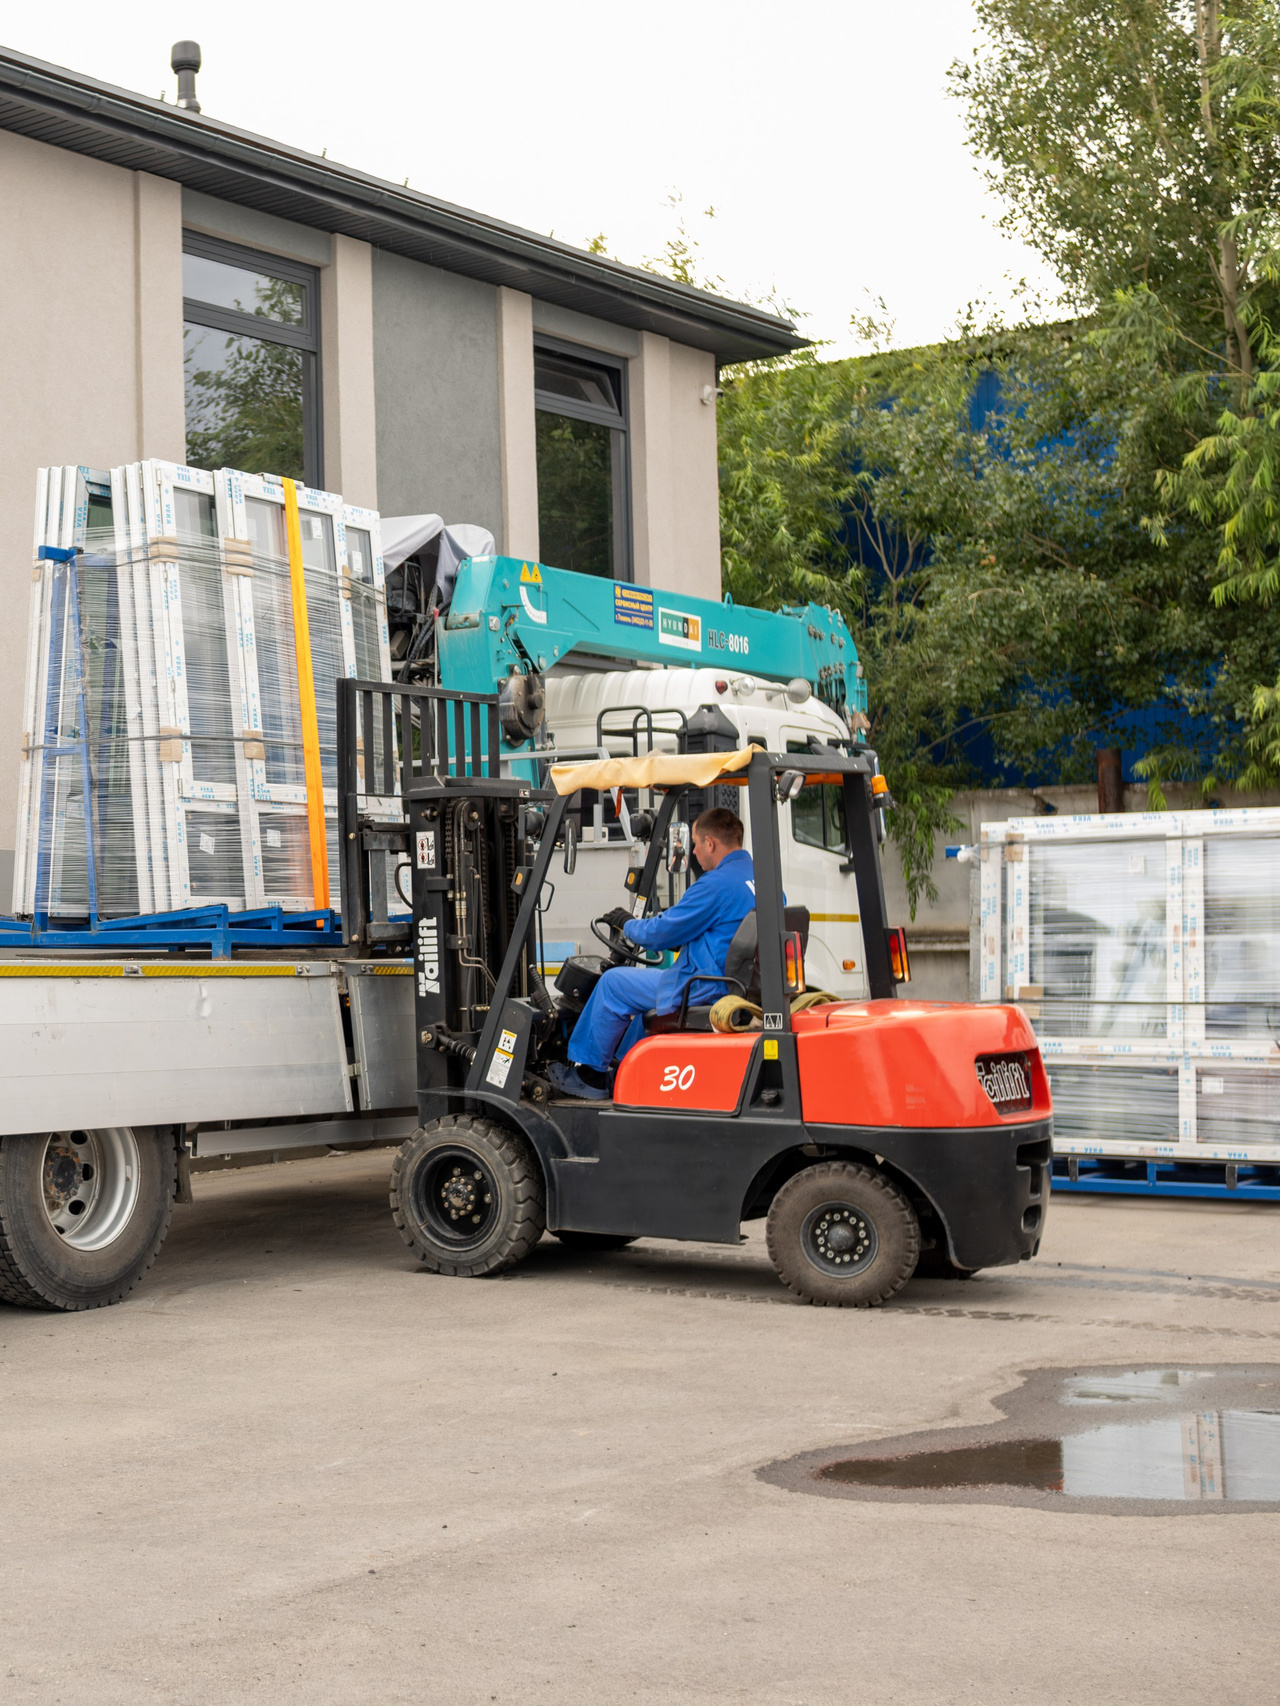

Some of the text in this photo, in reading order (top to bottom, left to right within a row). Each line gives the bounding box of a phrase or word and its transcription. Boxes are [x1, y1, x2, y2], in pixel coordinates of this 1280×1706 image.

[662, 617, 698, 636] HYUNDAI
[708, 628, 749, 655] HLC-8016
[1113, 1044, 1133, 1053] VEKA
[659, 1064, 696, 1092] 30
[1084, 1146, 1104, 1154] VEKA
[1228, 1152, 1248, 1160] VEKA
